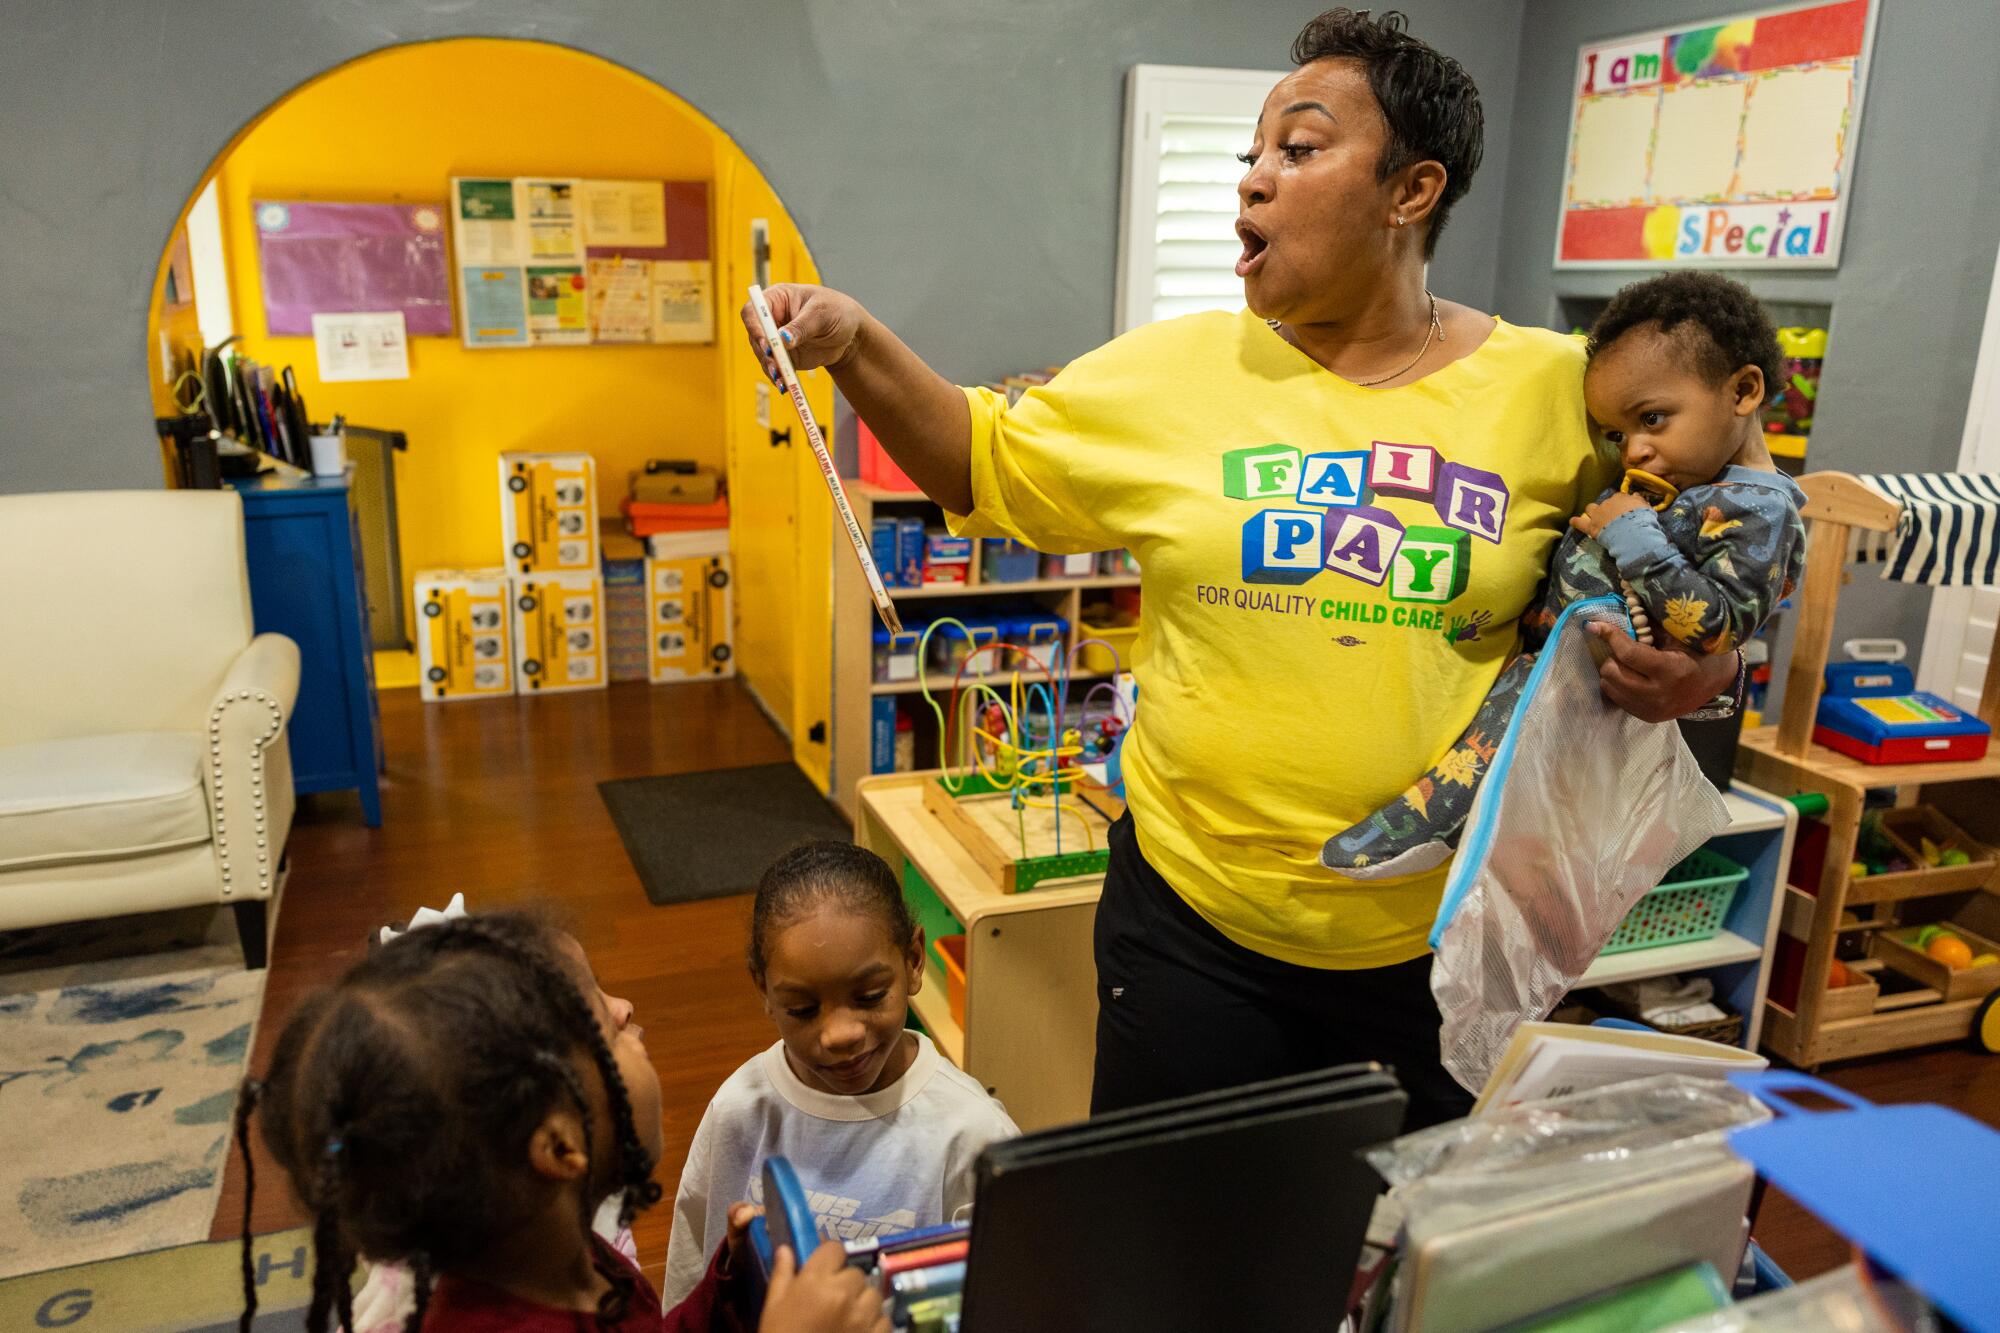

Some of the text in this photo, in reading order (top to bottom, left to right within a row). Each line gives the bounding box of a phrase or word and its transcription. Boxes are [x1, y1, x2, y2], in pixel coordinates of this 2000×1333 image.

[1585, 54, 1659, 93] I am
[816, 448, 833, 476] LLAMA
[1253, 450, 1498, 535] FAIR
[1272, 518, 1451, 593] PAY
[1197, 585, 1444, 631] FOR QUALITY CHILD CARE
[34, 1246, 307, 1329] G H
